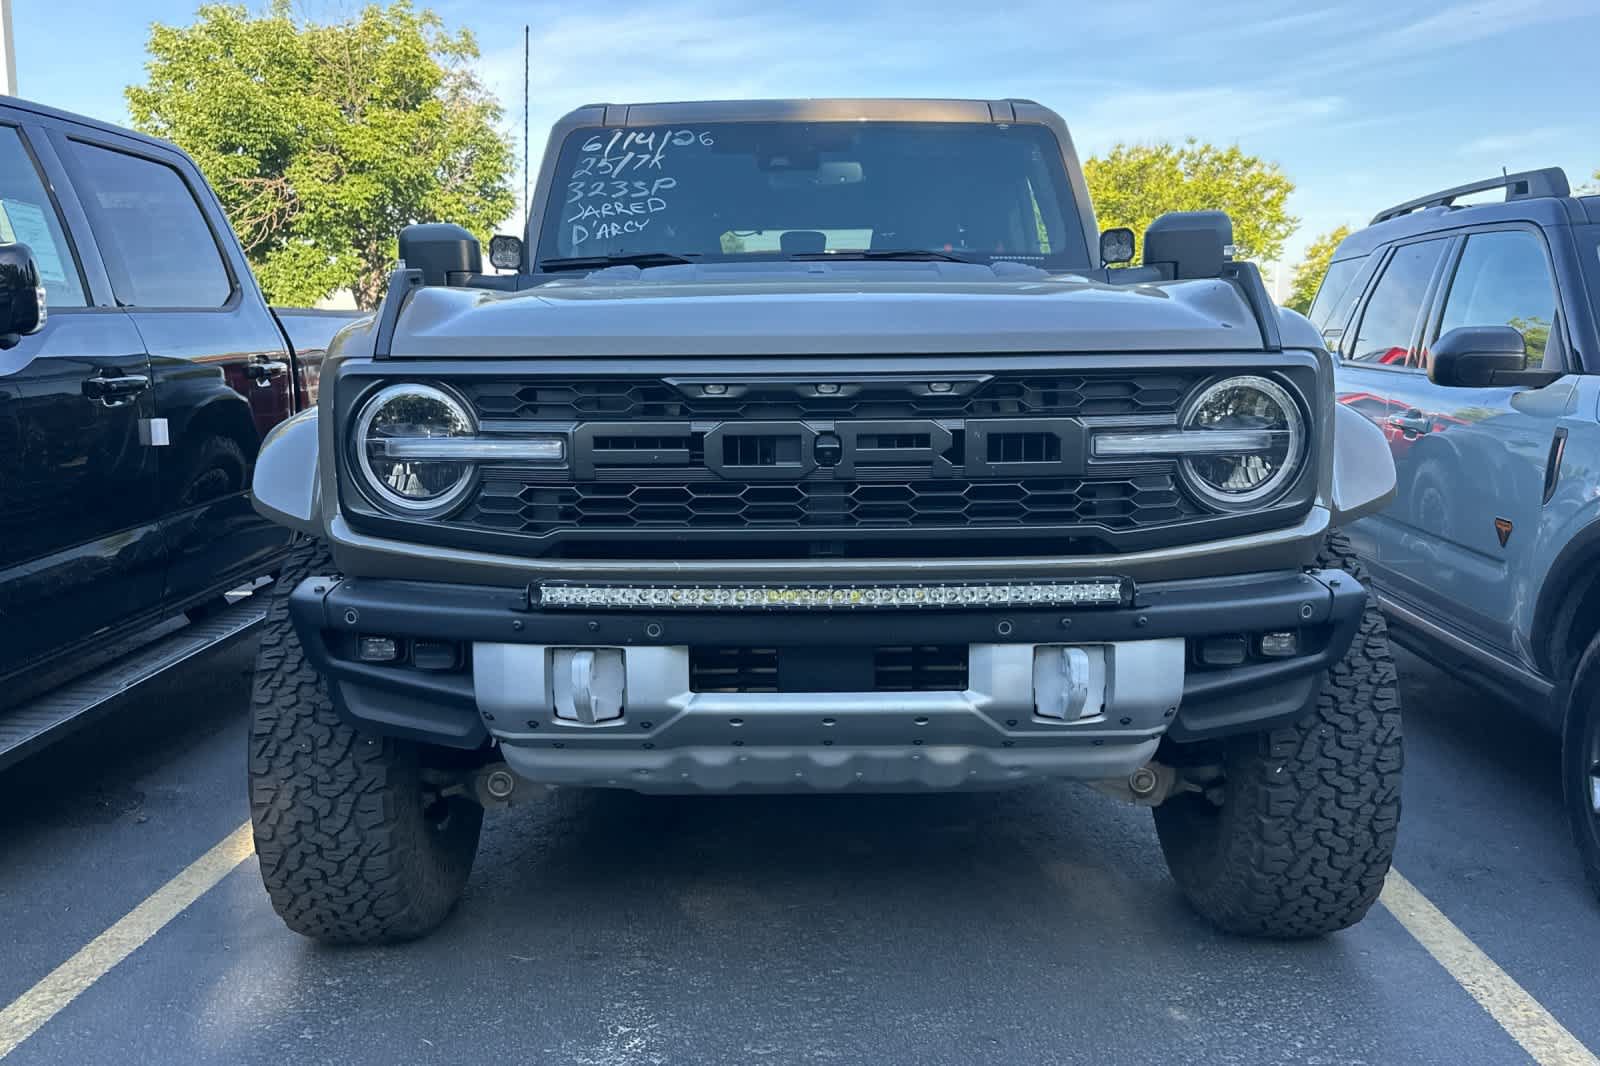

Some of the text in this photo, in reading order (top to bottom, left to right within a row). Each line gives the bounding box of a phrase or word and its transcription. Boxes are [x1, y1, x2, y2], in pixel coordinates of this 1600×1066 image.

[567, 198, 666, 223] JARRED
[572, 218, 650, 245] D'ARCY
[570, 418, 1086, 481] FORD
